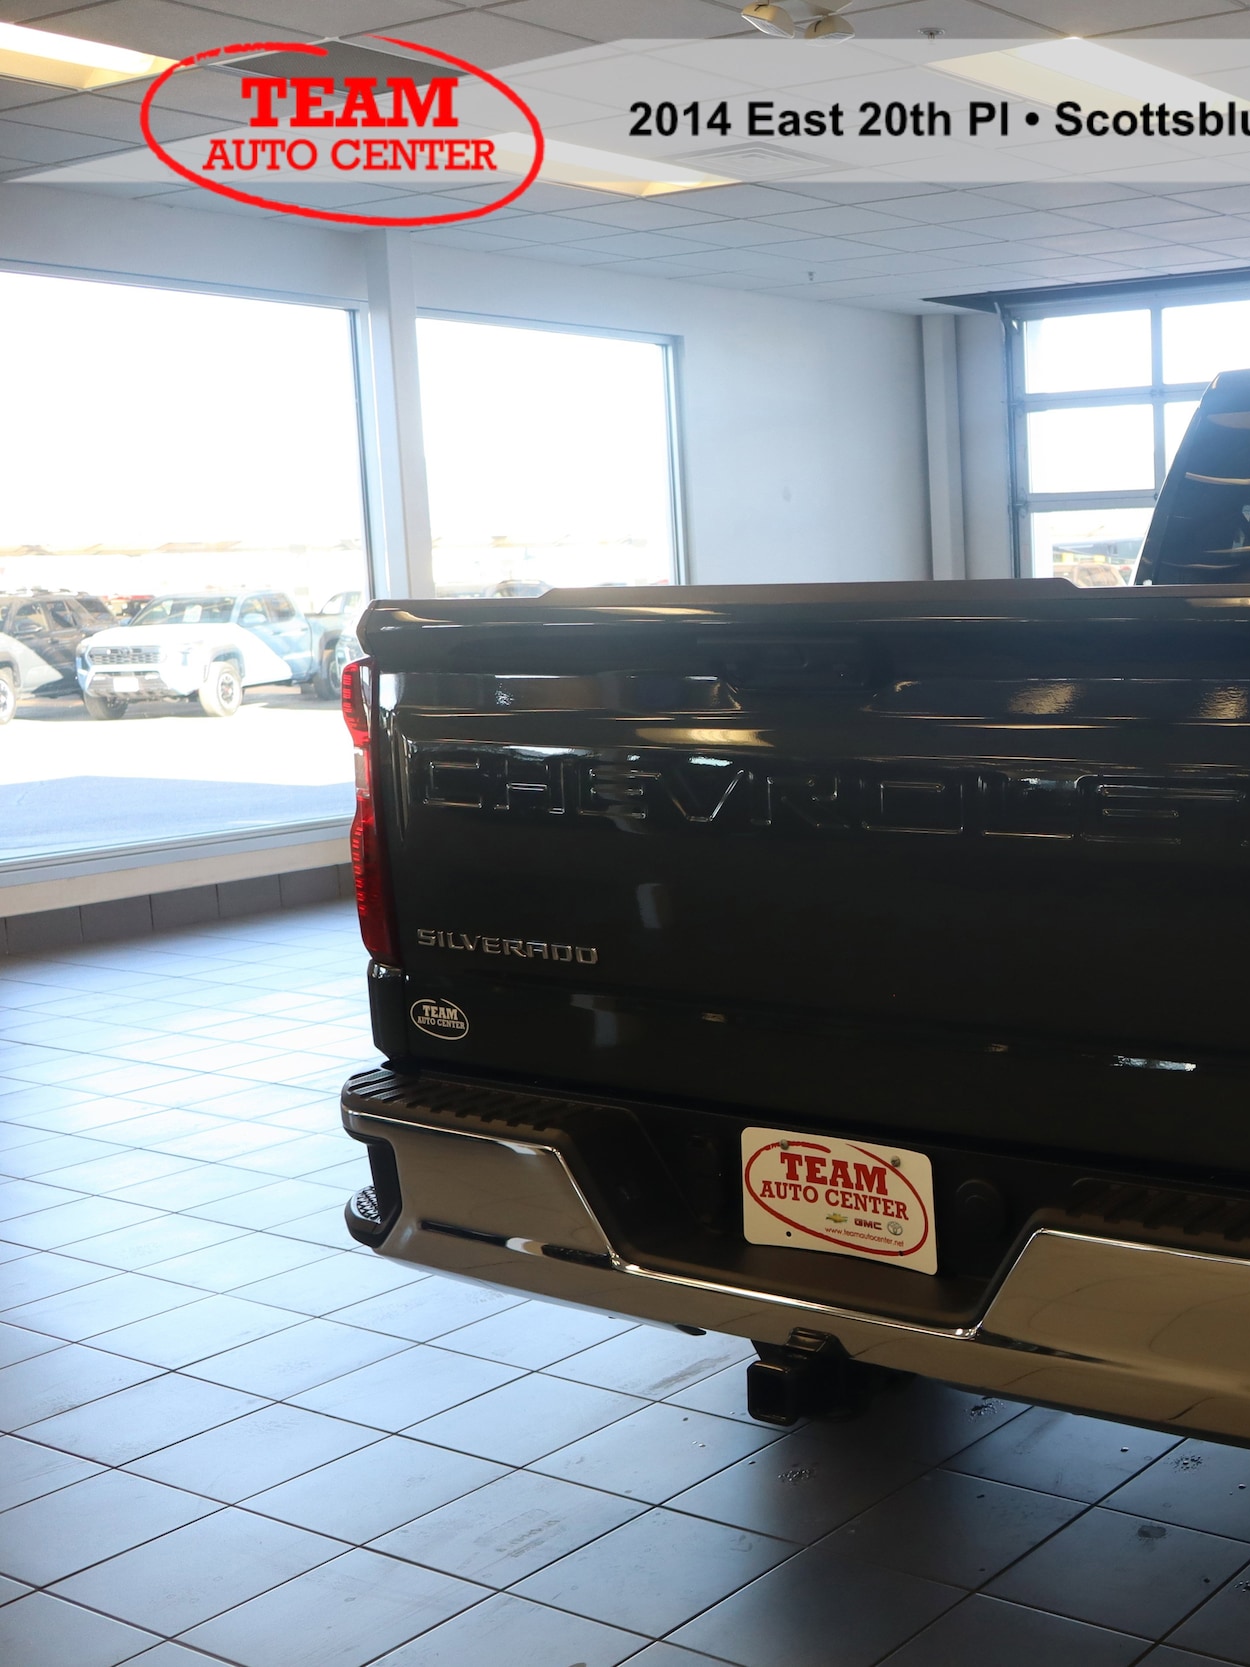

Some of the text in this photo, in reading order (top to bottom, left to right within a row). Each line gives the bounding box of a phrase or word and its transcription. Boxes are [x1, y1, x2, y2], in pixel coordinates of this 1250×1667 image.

[417, 928, 599, 965] SILVERADO
[417, 1016, 466, 1030] AUTO CENTER
[422, 1005, 458, 1020] TEAM
[780, 1151, 888, 1196] TEAM
[759, 1180, 909, 1221] AUTO CENTER
[854, 1217, 882, 1231] GMC
[824, 1226, 905, 1248] www.teamautocenter.net
